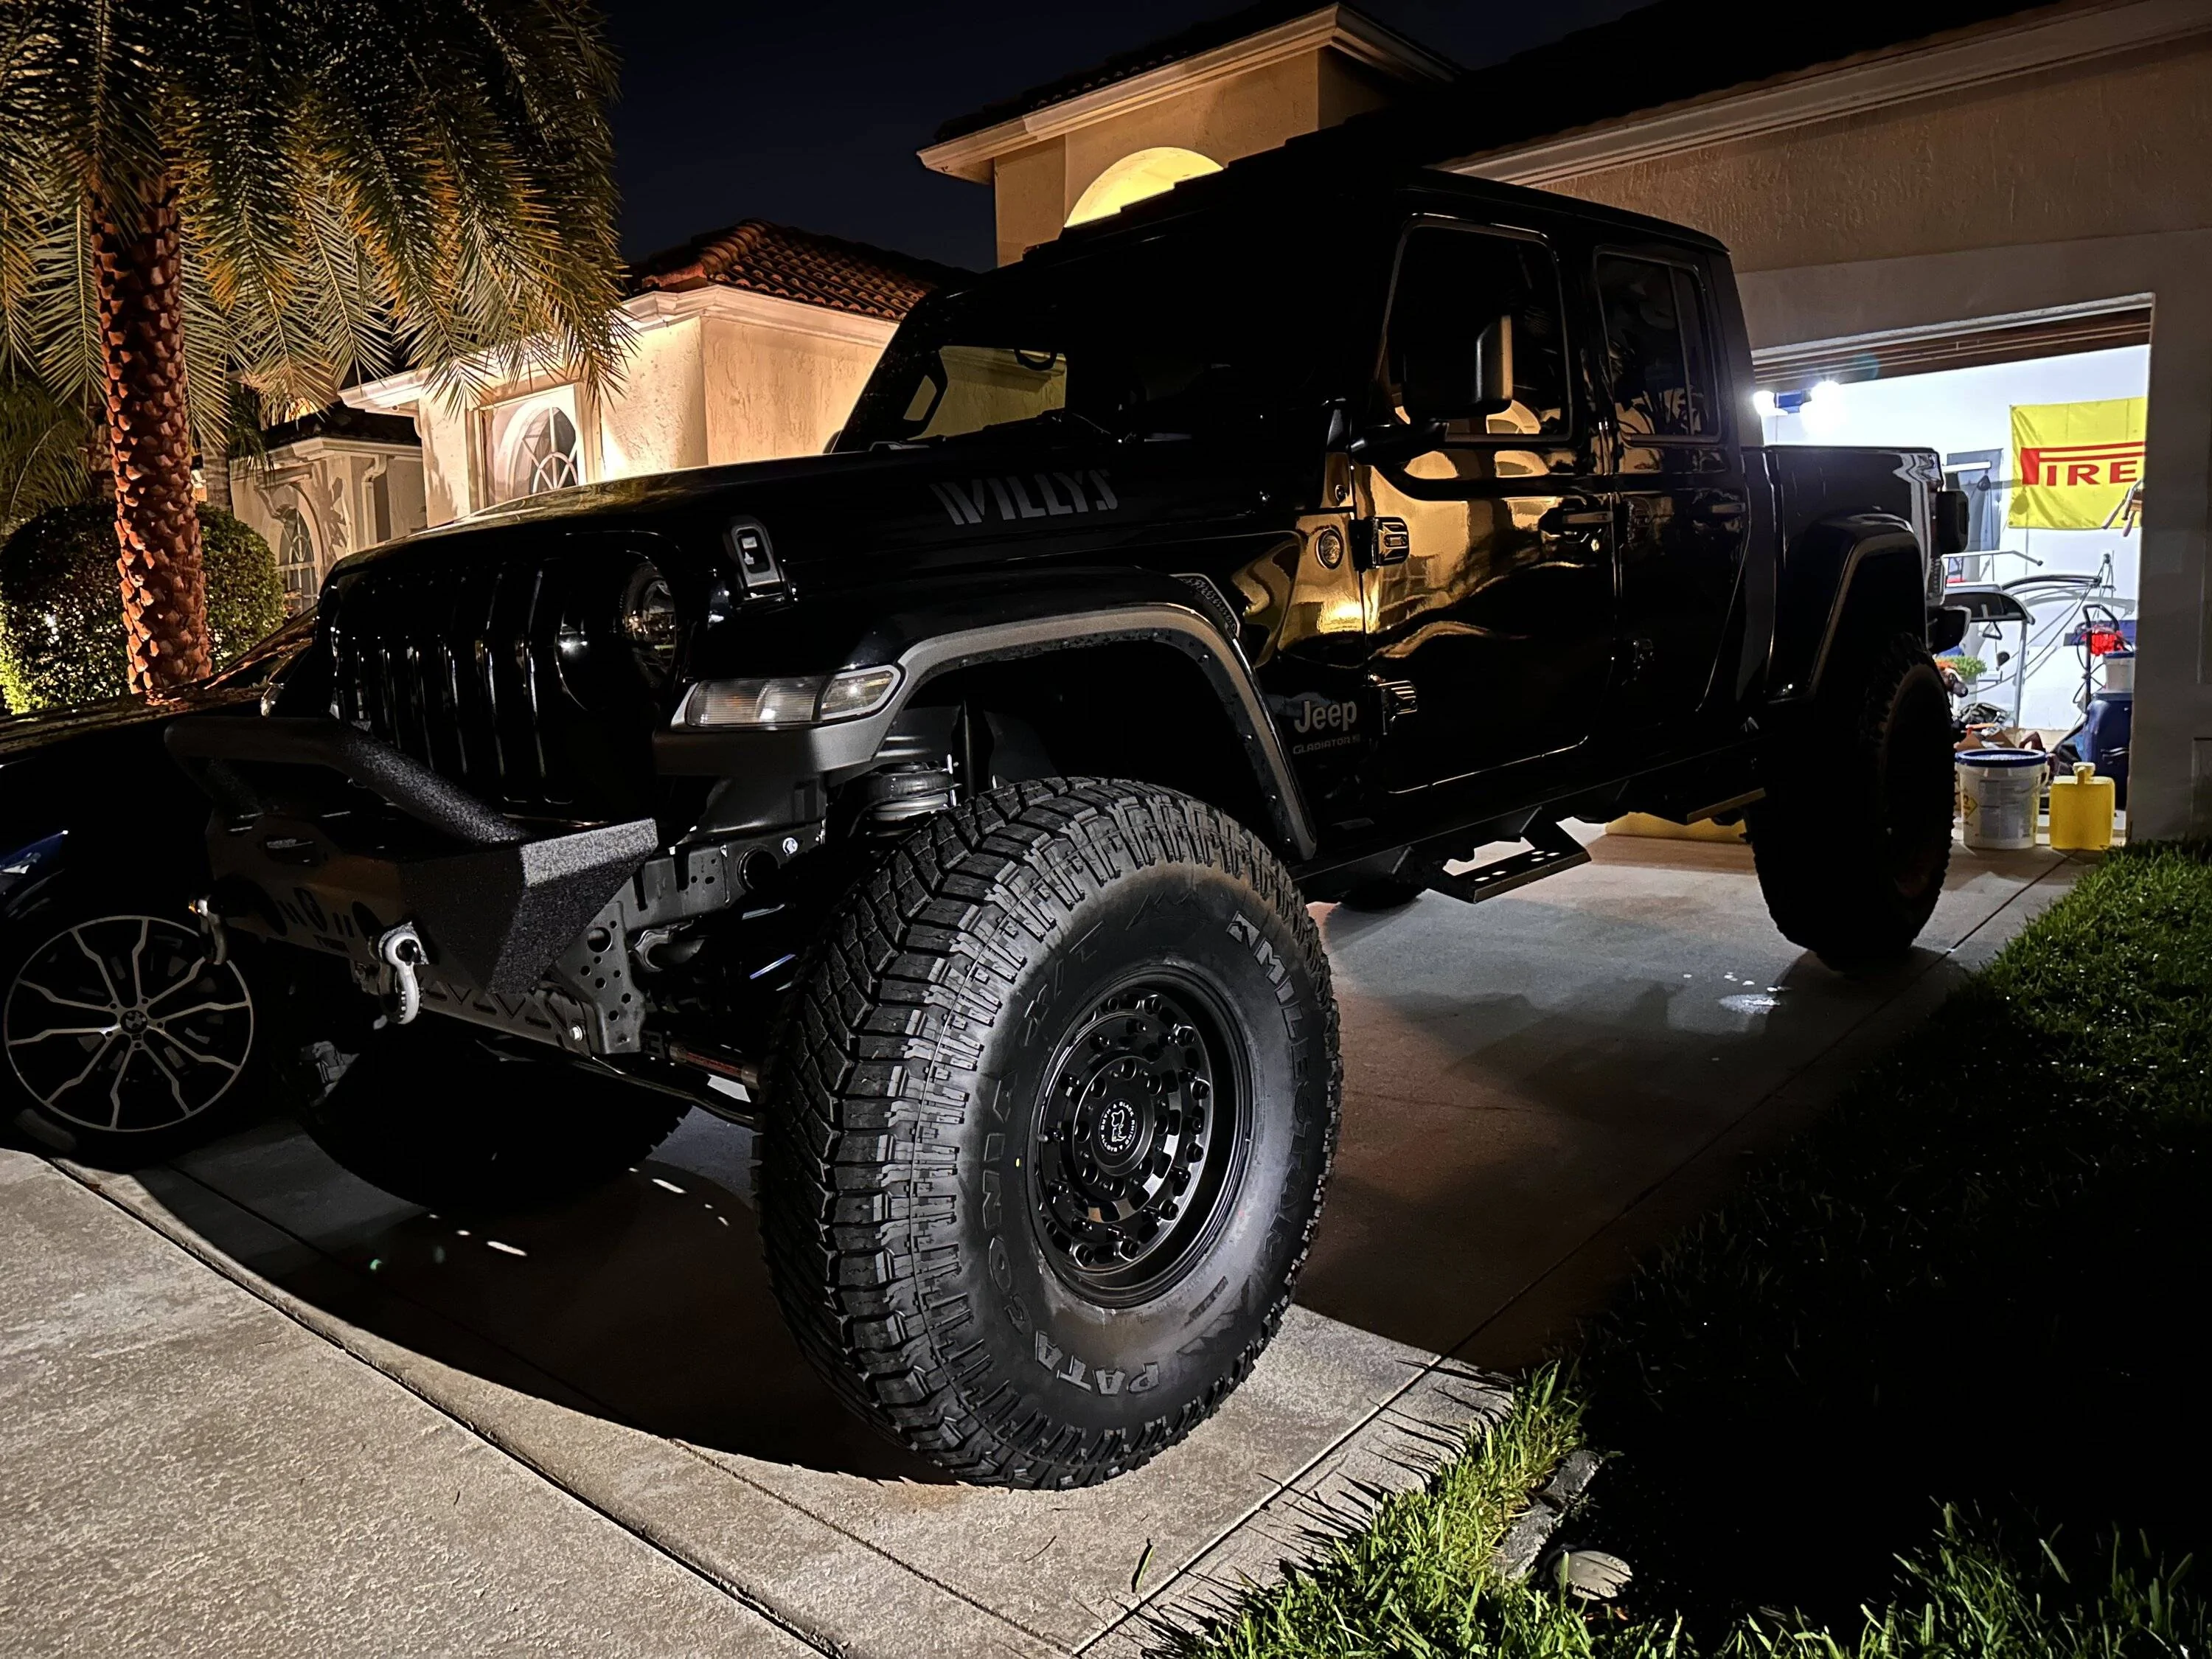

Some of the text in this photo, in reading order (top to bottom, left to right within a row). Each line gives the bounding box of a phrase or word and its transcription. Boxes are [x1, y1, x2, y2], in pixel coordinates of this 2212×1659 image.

[928, 469, 1119, 525] WILLYS
[1294, 700, 1357, 734] Jeep
[1292, 737, 1352, 755] GLADIATOR
